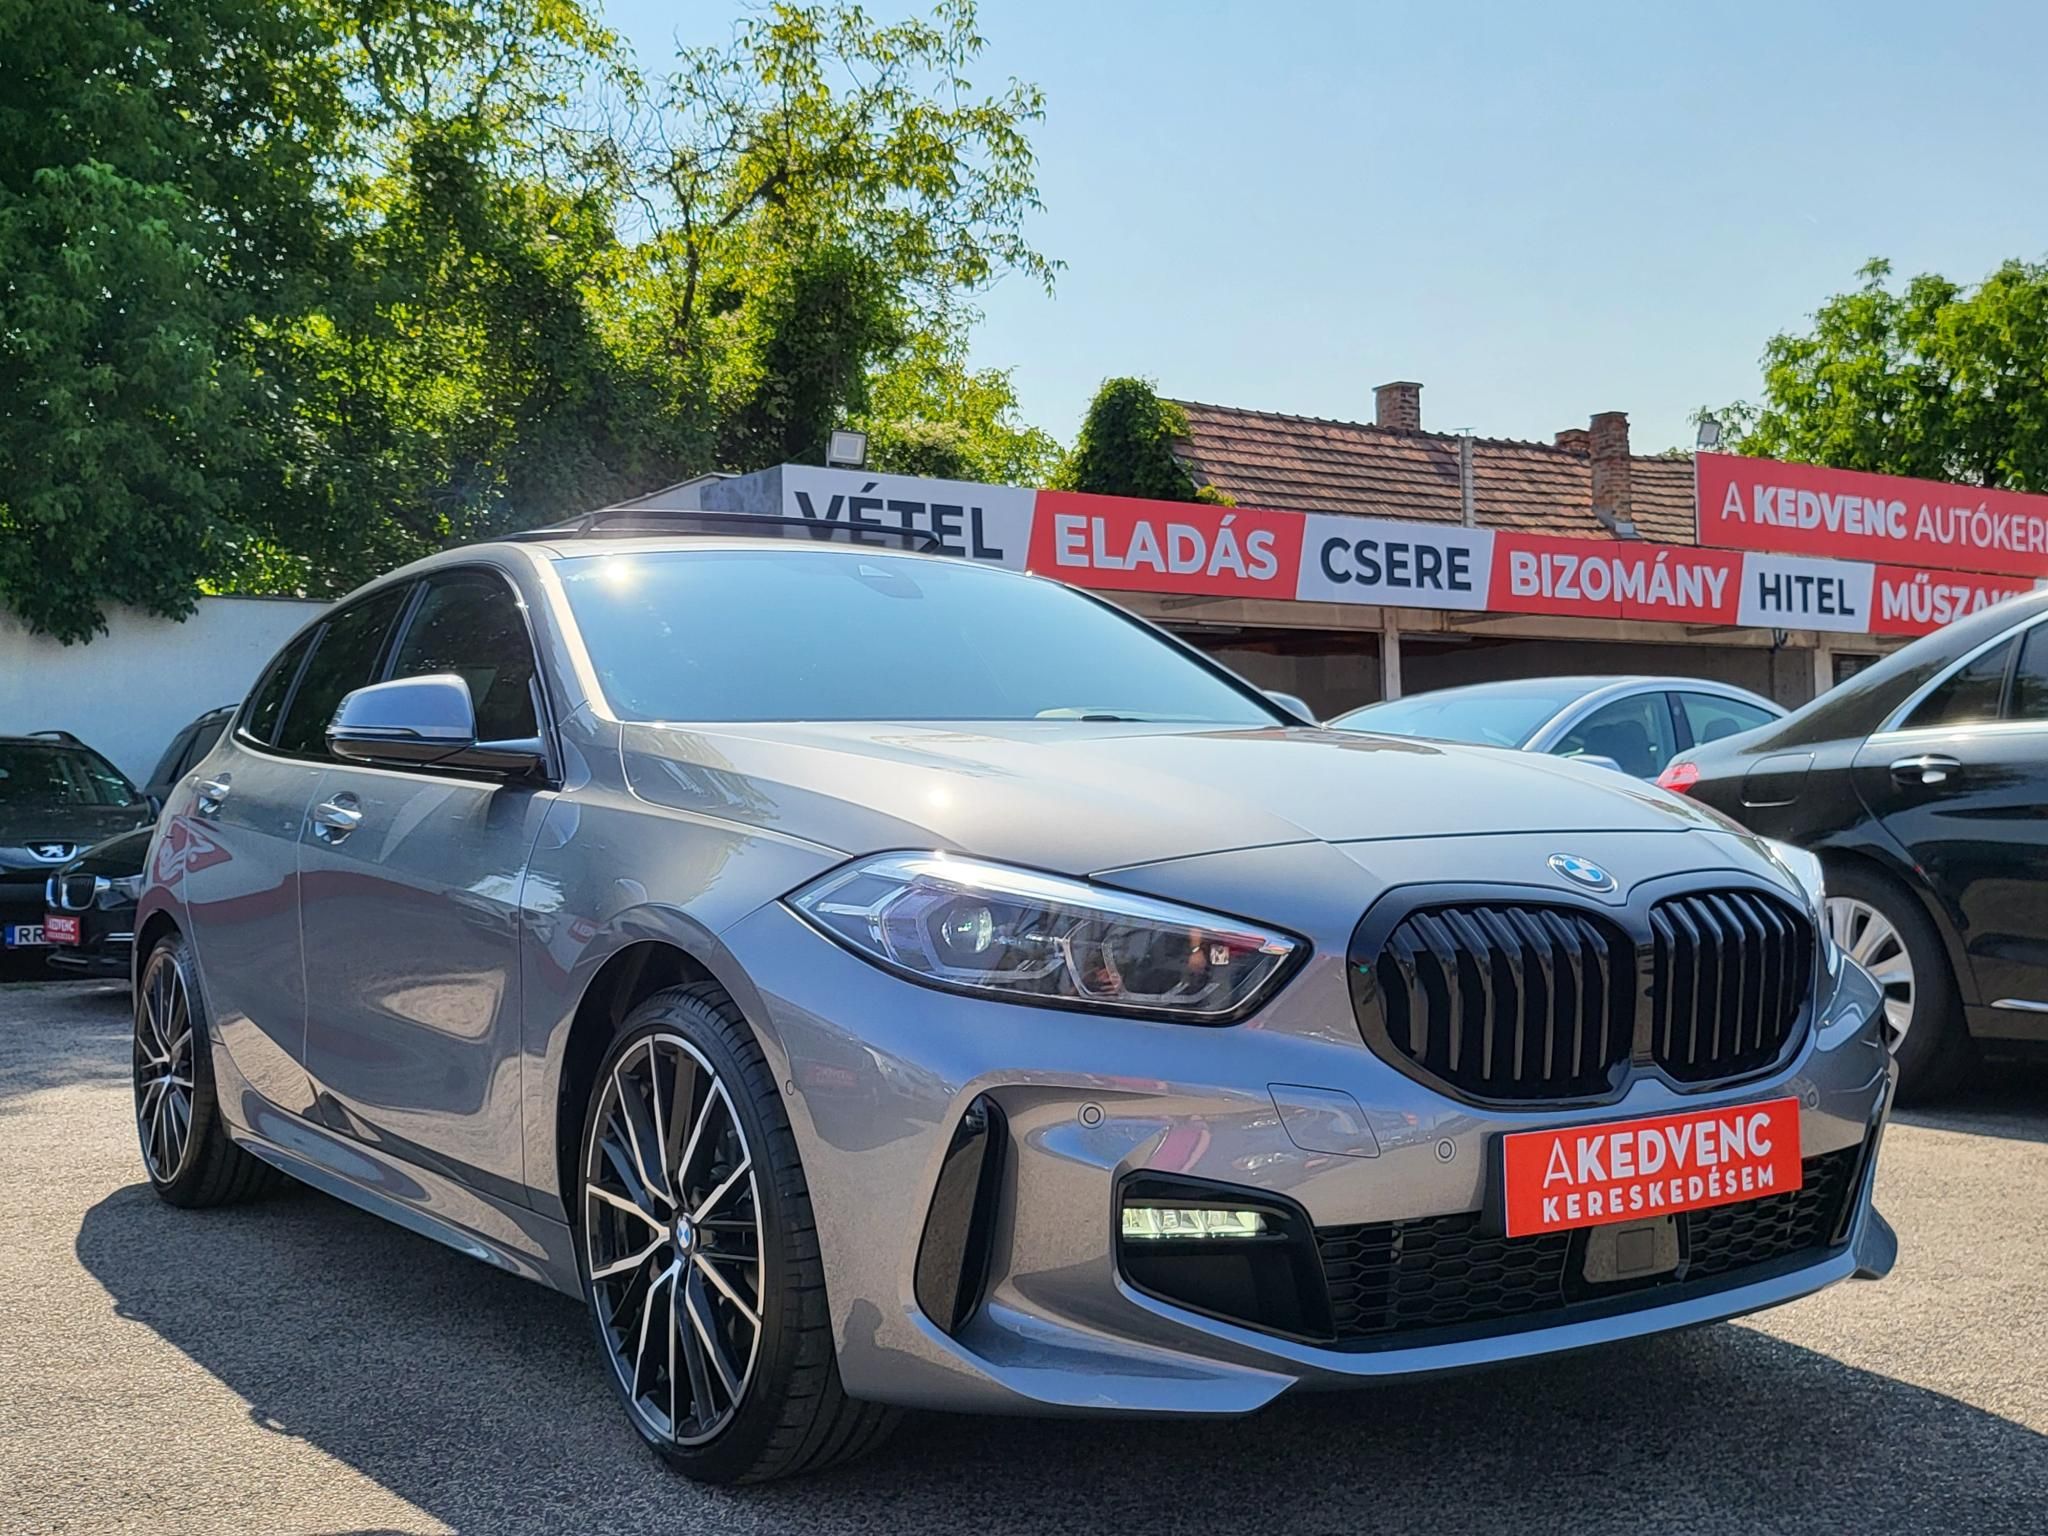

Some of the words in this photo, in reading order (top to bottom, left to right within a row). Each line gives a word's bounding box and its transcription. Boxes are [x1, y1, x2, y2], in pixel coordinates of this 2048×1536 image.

[794, 482, 1003, 560] VÉTEL
[1054, 513, 1278, 581] ELADÁS
[1721, 481, 1746, 522] A
[1753, 484, 1908, 539] KEDVENC
[1914, 501, 2048, 554] AUTÓKER
[1320, 537, 1472, 592] CSERE
[1510, 551, 1729, 609] BIZOMÁNY
[1759, 572, 1855, 616] HITEL
[1543, 1164, 1774, 1224] KERESKEDÉSEM
